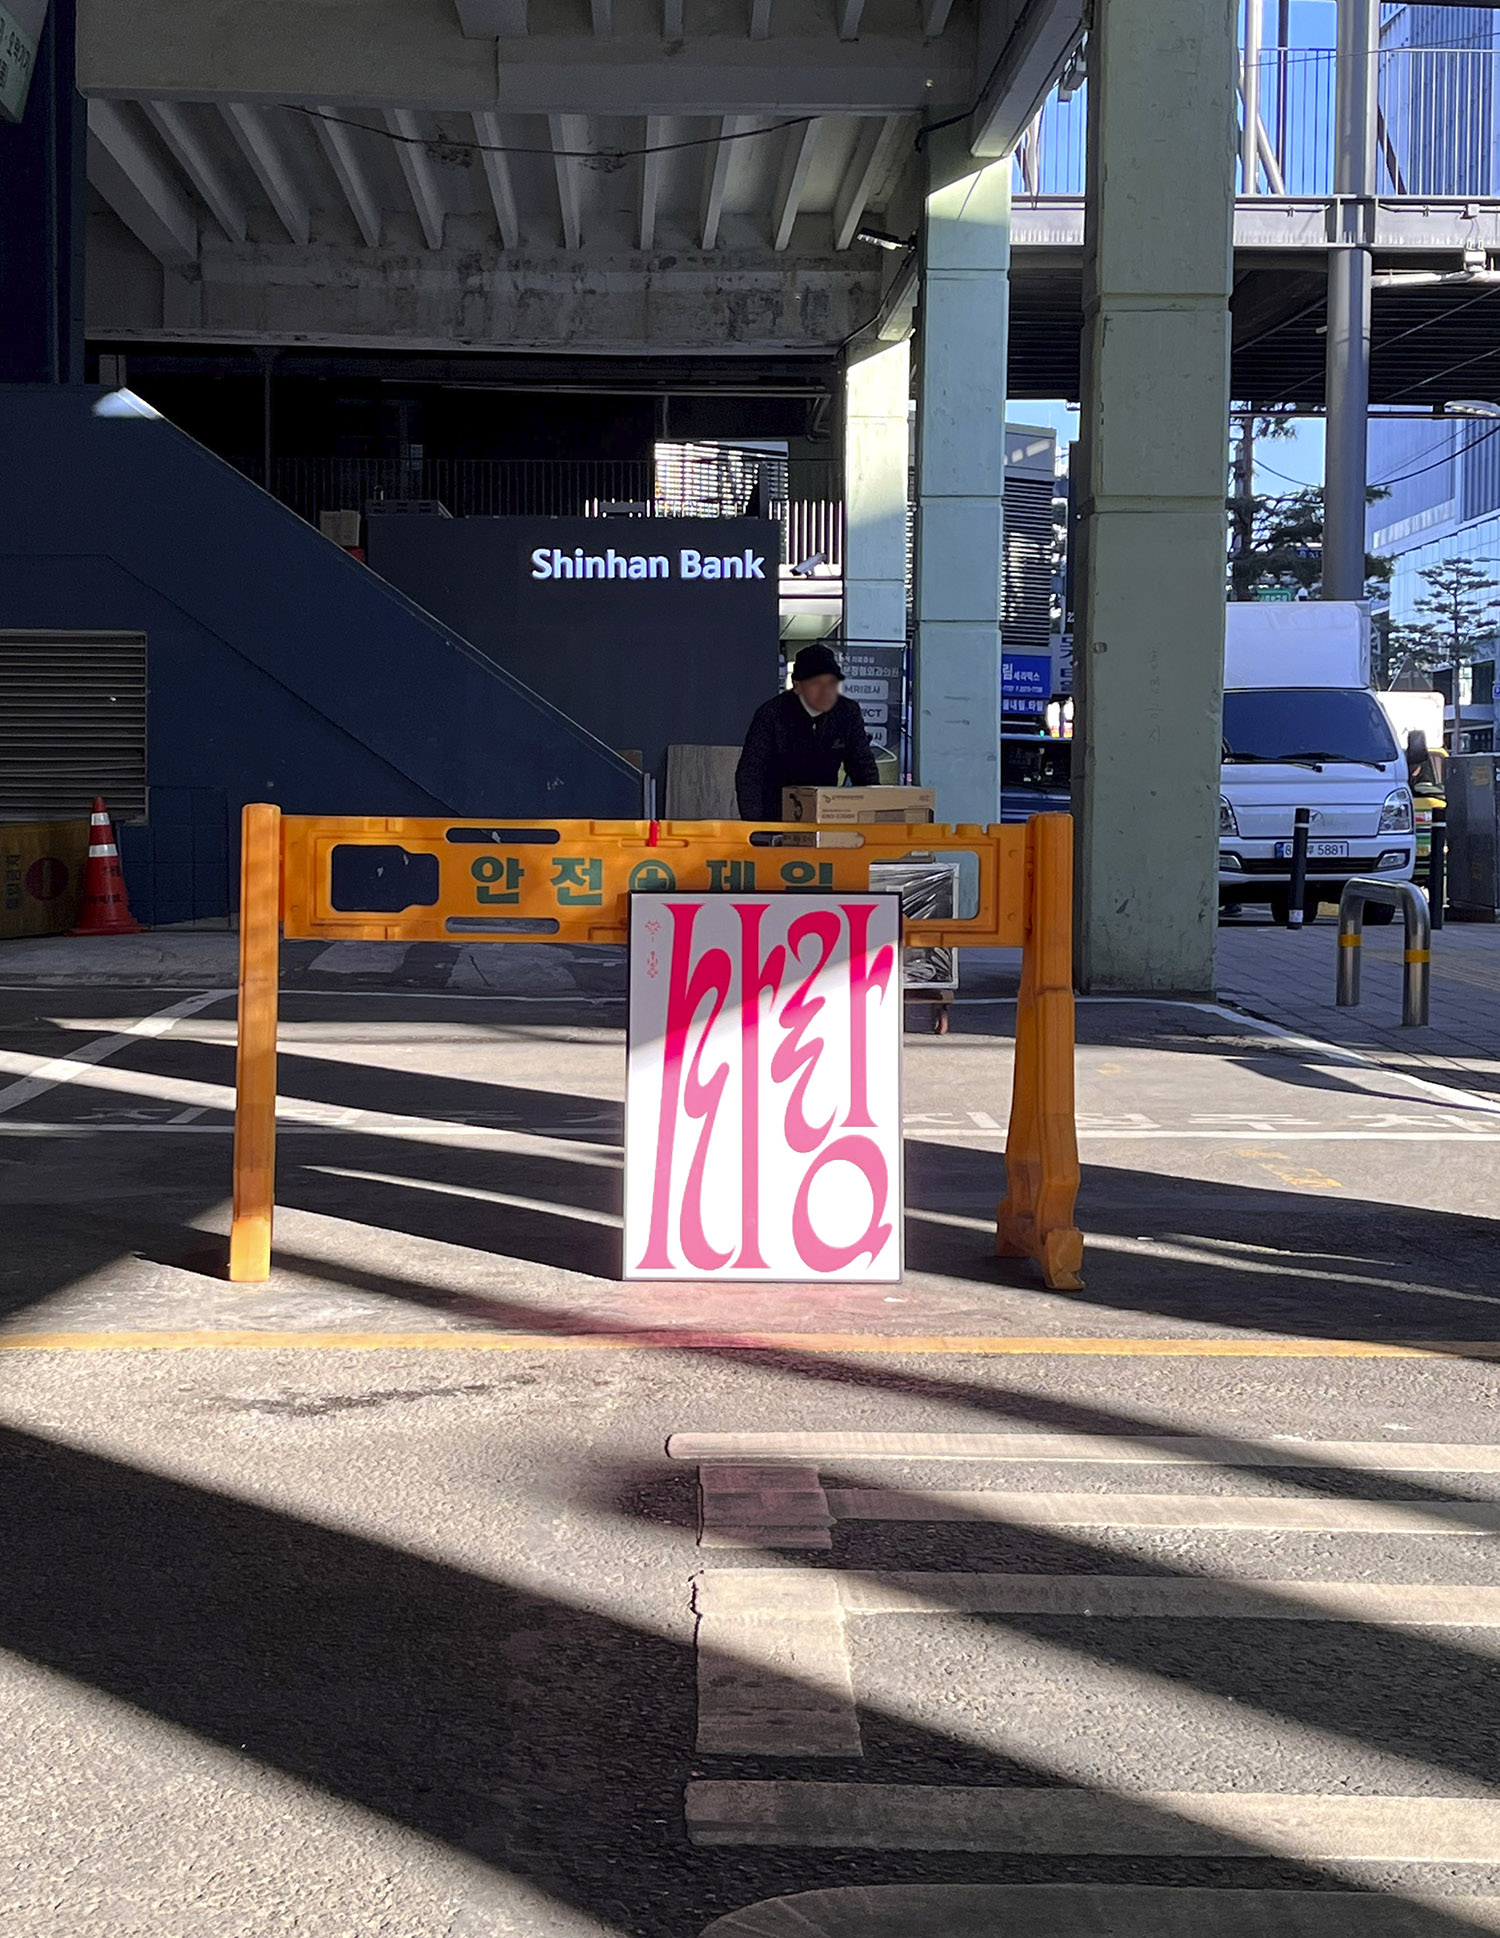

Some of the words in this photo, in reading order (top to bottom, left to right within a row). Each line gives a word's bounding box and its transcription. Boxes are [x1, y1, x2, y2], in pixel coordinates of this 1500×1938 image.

[532, 548, 670, 580] Shinhan
[680, 548, 766, 580] Bank
[1317, 844, 1344, 856] 5881
[470, 856, 603, 906] 안전
